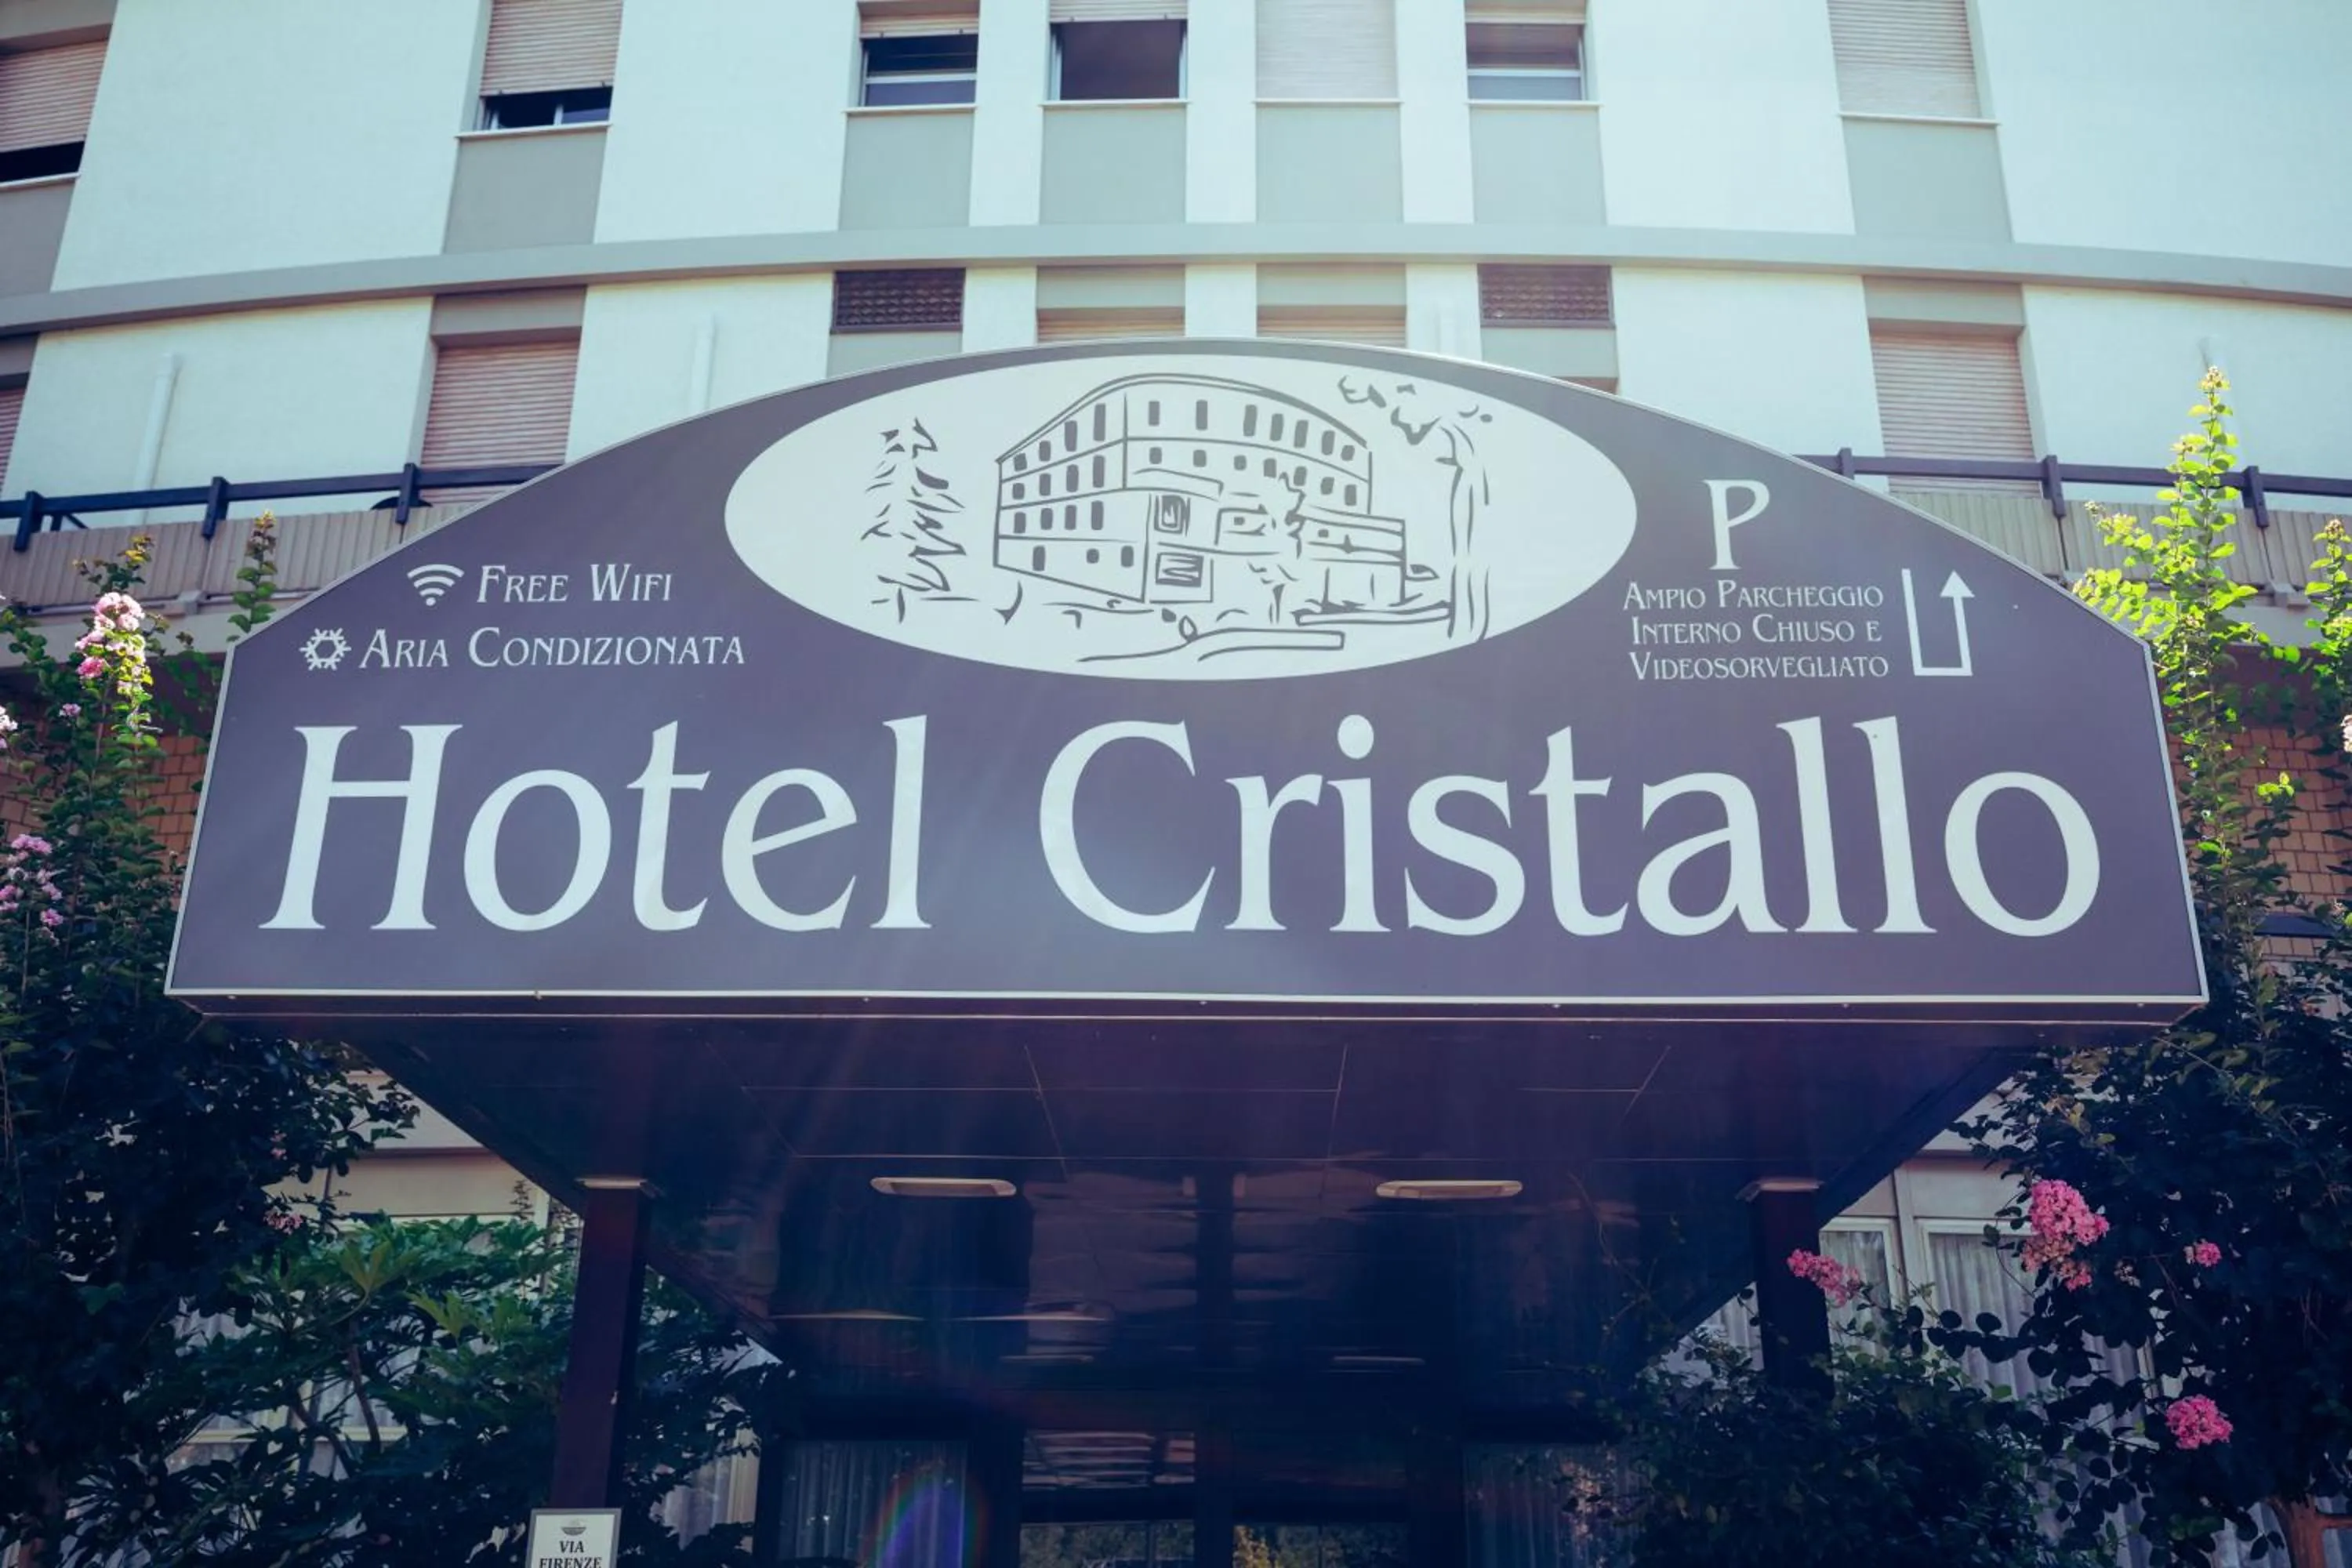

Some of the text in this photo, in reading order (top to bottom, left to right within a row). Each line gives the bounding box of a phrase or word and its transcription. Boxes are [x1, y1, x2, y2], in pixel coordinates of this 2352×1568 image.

[1704, 480, 1769, 569] P
[1866, 621, 1882, 641] E
[260, 715, 2100, 936] Hotel Cristallo
[559, 1541, 584, 1553] VIA
[539, 1557, 602, 1568] FIRENZE
